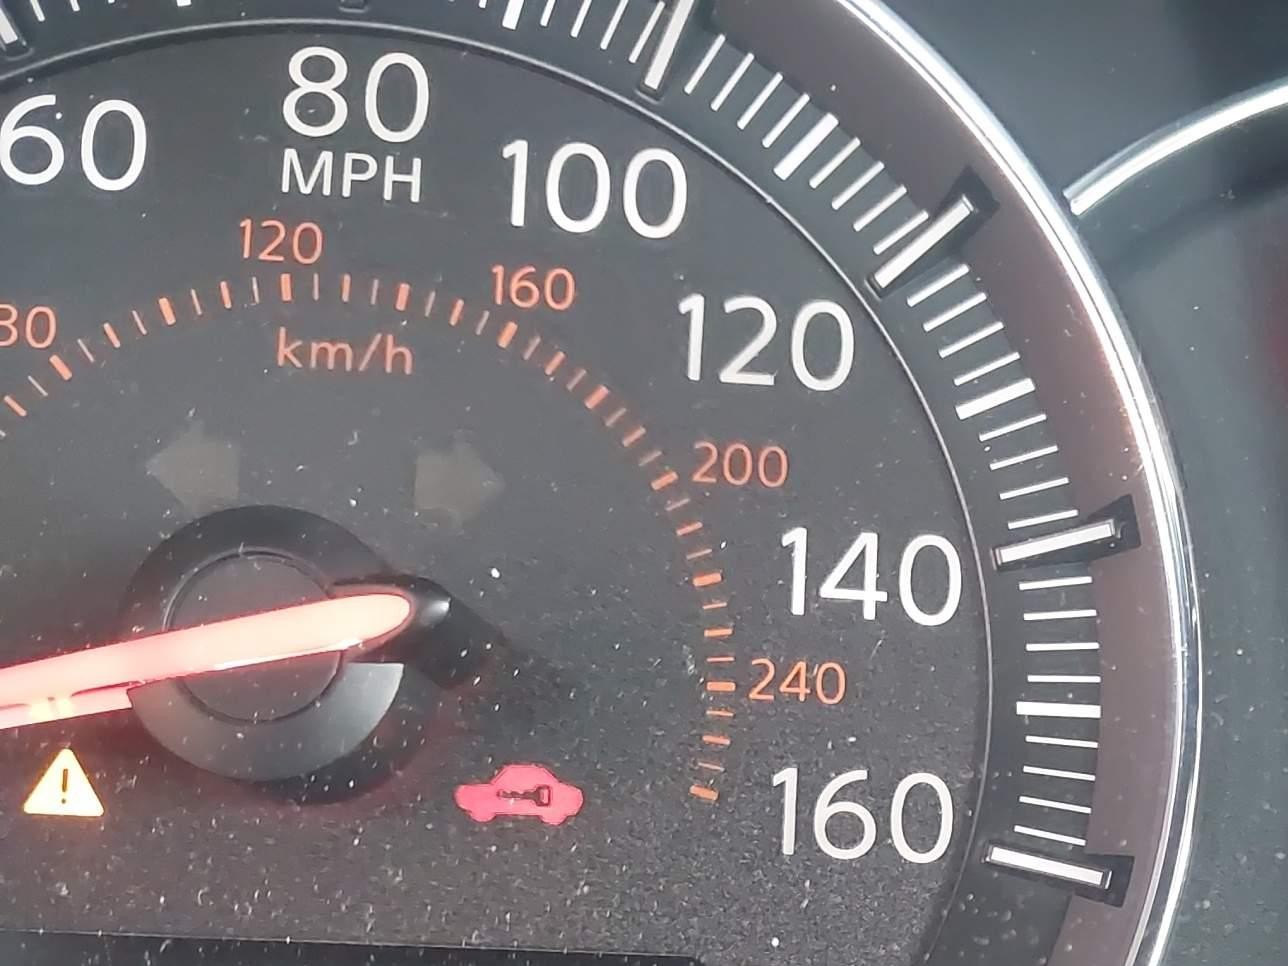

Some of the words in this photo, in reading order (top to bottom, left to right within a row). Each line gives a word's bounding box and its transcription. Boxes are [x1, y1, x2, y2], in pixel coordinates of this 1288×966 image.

[283, 47, 429, 142] 80
[0, 94, 147, 191] 60
[282, 148, 421, 203] MPH
[503, 139, 687, 238] 100
[240, 219, 323, 264] 120
[491, 266, 576, 310] 160
[275, 326, 415, 375] km/h
[678, 295, 855, 391] 120
[692, 442, 788, 487] 200
[782, 528, 963, 626] 140
[748, 661, 846, 705] 240
[771, 768, 953, 863] 160
